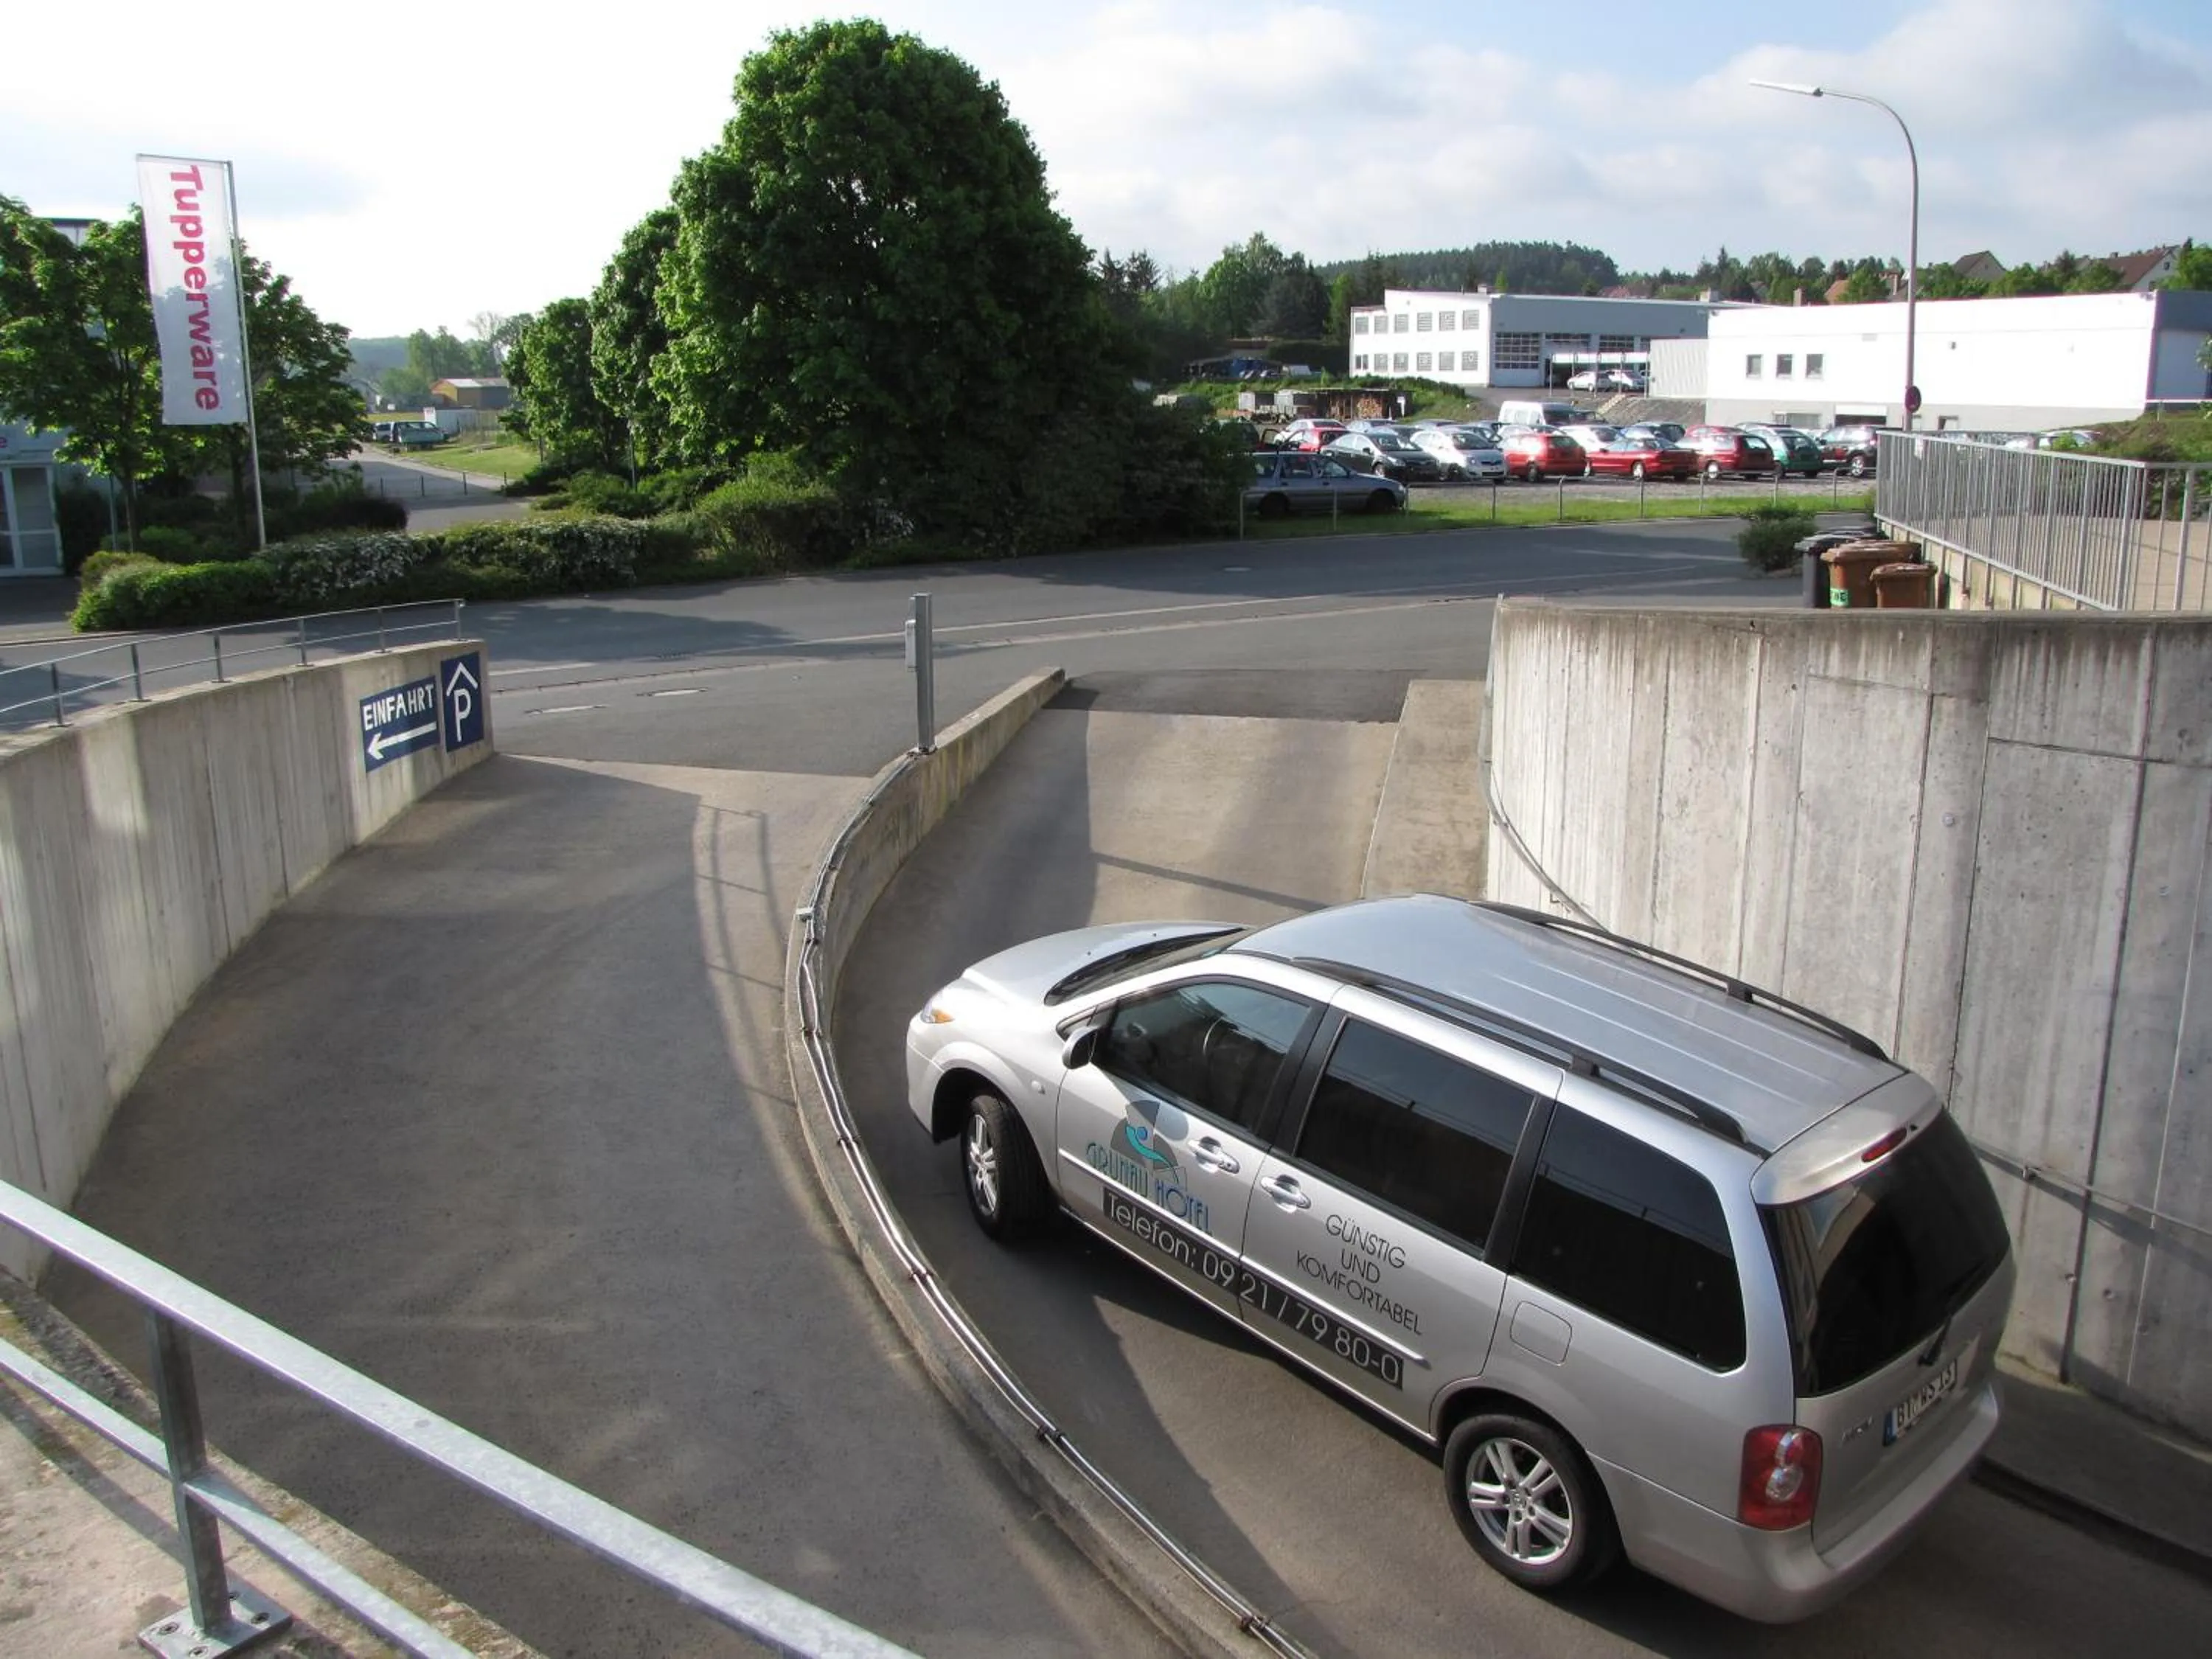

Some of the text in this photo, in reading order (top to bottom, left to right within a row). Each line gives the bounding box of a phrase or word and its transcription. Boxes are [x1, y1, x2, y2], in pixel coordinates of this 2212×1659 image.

[170, 165, 220, 410] Tupperware
[363, 684, 434, 731] EINFAHRT
[453, 688, 471, 742] P
[1108, 1192, 1197, 1268] Telefon:
[1154, 1179, 1214, 1237] HOTEL
[1326, 1214, 1406, 1269] GÜNSTIG
[1341, 1248, 1381, 1284] UND
[1296, 1250, 1424, 1336] KOMFORTABEL
